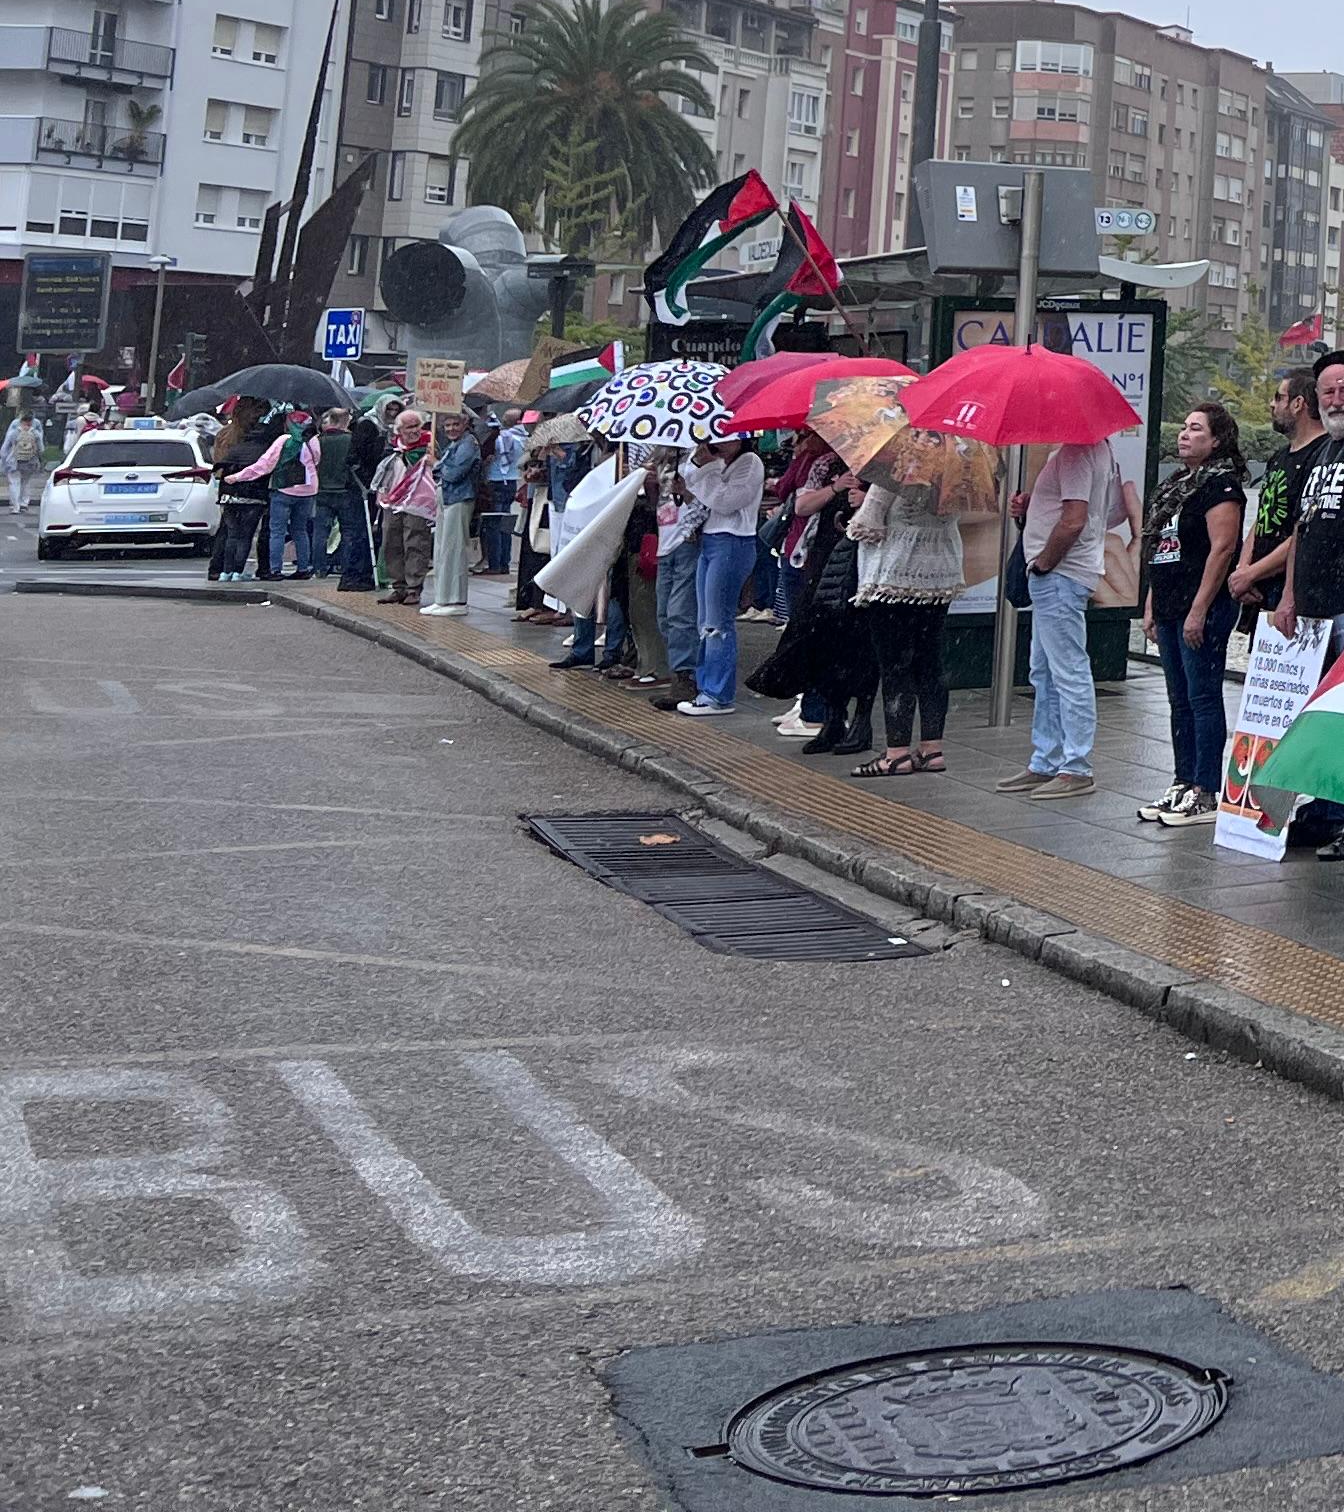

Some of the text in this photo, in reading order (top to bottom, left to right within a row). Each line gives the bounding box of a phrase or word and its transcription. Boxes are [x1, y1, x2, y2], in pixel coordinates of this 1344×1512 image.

[328, 324, 361, 345] TAXI
[957, 313, 1146, 353] CADALÍE
[671, 338, 741, 353] Cuando
[1257, 638, 1283, 655] Más de
[1299, 665, 1305, 680] y
[1270, 679, 1309, 695] asesinados
[1245, 694, 1294, 711] y muertos de
[1271, 715, 1281, 726] en
[0, 1046, 1045, 1318] BUS
